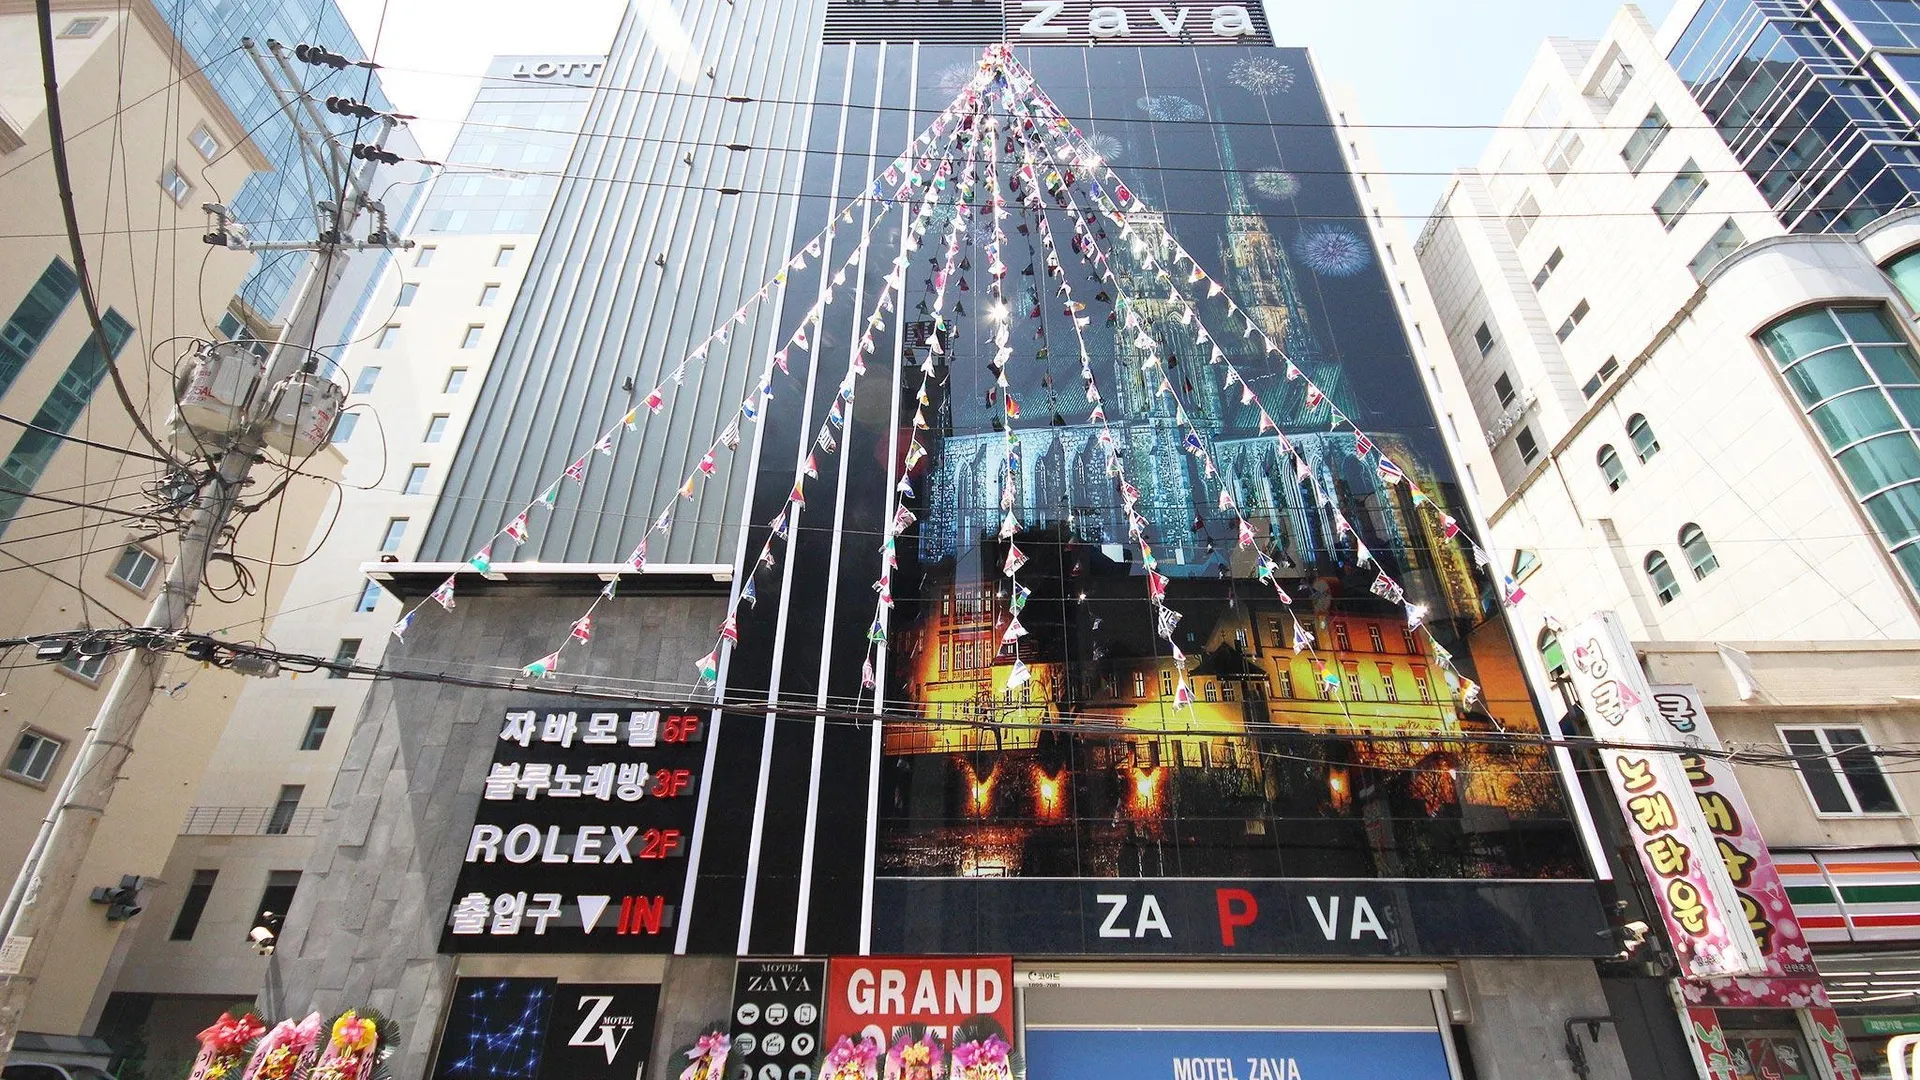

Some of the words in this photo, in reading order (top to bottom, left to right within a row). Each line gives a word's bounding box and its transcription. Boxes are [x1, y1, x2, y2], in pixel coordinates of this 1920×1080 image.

[1020, 0, 1256, 37] Zava
[499, 710, 660, 748] 자바모텔
[663, 715, 698, 743] 5F
[485, 762, 649, 801] 블루노래방
[652, 769, 690, 798] 3F
[465, 824, 639, 864] ROLEX
[639, 829, 681, 859] 2F
[1616, 755, 1709, 938] 노래타운
[452, 891, 562, 935] 출입구
[616, 895, 664, 935] IN
[1216, 888, 1259, 947] P
[747, 976, 811, 992] ZAVA
[761, 964, 802, 973] MOTEL
[847, 968, 1003, 1015] GRAND
[602, 1016, 634, 1025] MOTEL
[1173, 1057, 1239, 1080] MOTEL
[1247, 1057, 1302, 1080] ZAVA
